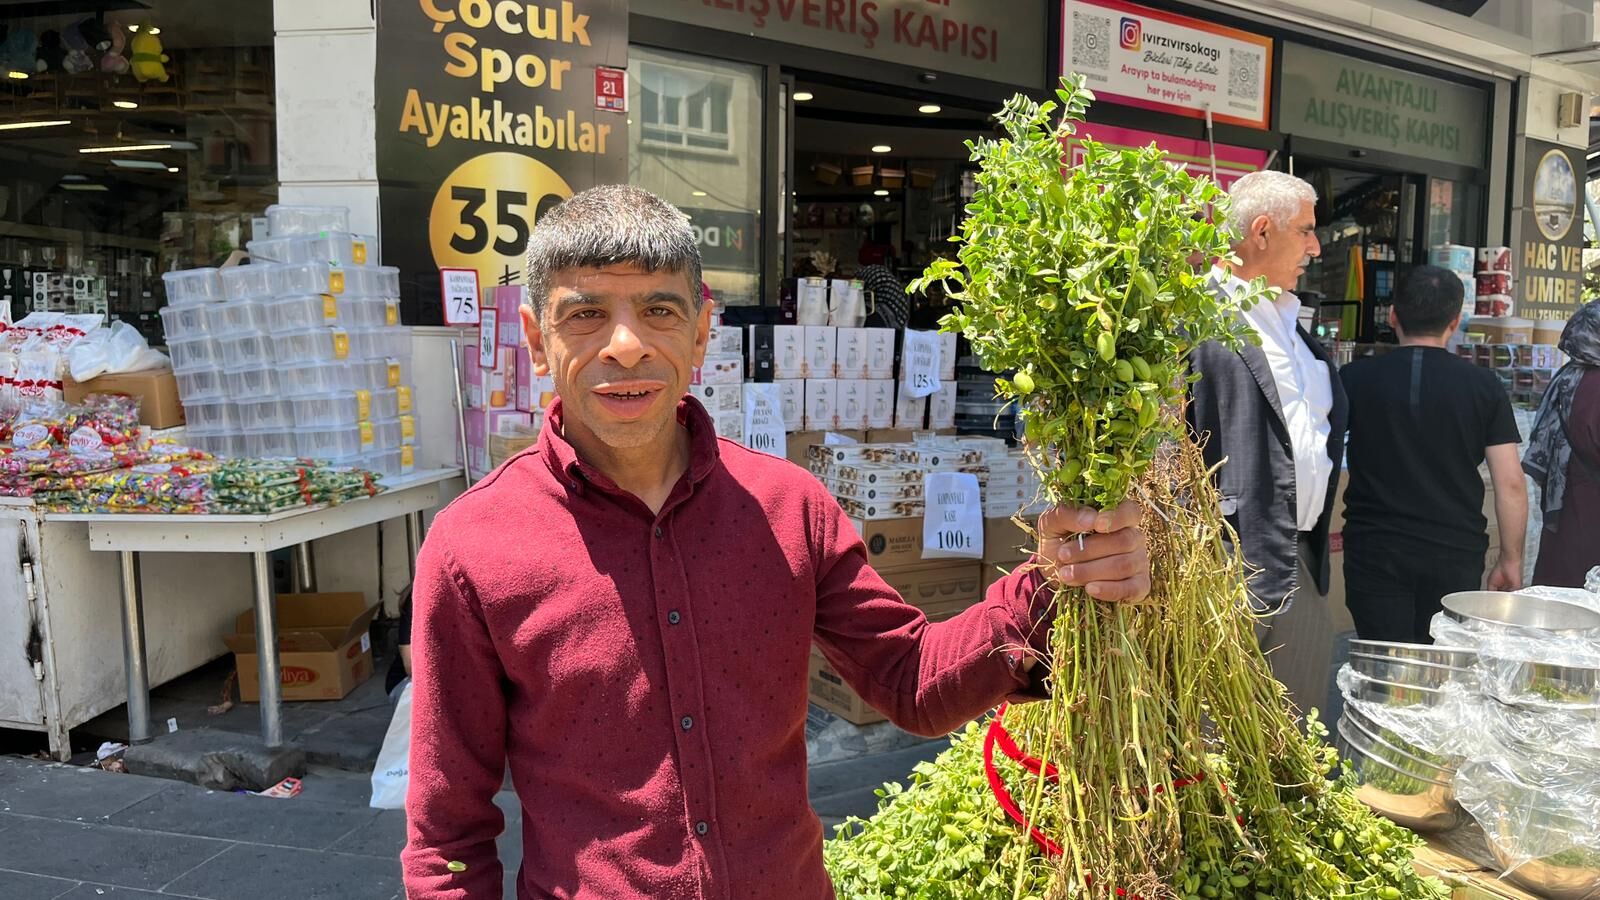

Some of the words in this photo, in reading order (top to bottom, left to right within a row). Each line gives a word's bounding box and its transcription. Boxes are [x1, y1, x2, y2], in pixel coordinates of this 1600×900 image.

[419, 0, 592, 47] Çocuk
[894, 8, 998, 63] KAPISI
[444, 32, 571, 93] Spor
[1120, 64, 1149, 81] Arayıp
[1151, 70, 1160, 80] ta
[1162, 71, 1217, 92] bulamadığınız
[603, 81, 617, 95] 21
[1146, 84, 1160, 96] her
[1162, 89, 1176, 102] şey
[1177, 89, 1191, 103] için
[1336, 67, 1438, 112] AVANTAJLI
[400, 88, 612, 155] Ayakkabılar
[1304, 97, 1400, 148] ALIŞVERİŞ
[1406, 117, 1460, 151] KAPISI
[1523, 242, 1557, 271] HAC
[1560, 246, 1582, 273] VE
[453, 297, 474, 318] 75
[1525, 276, 1576, 305] UMRE
